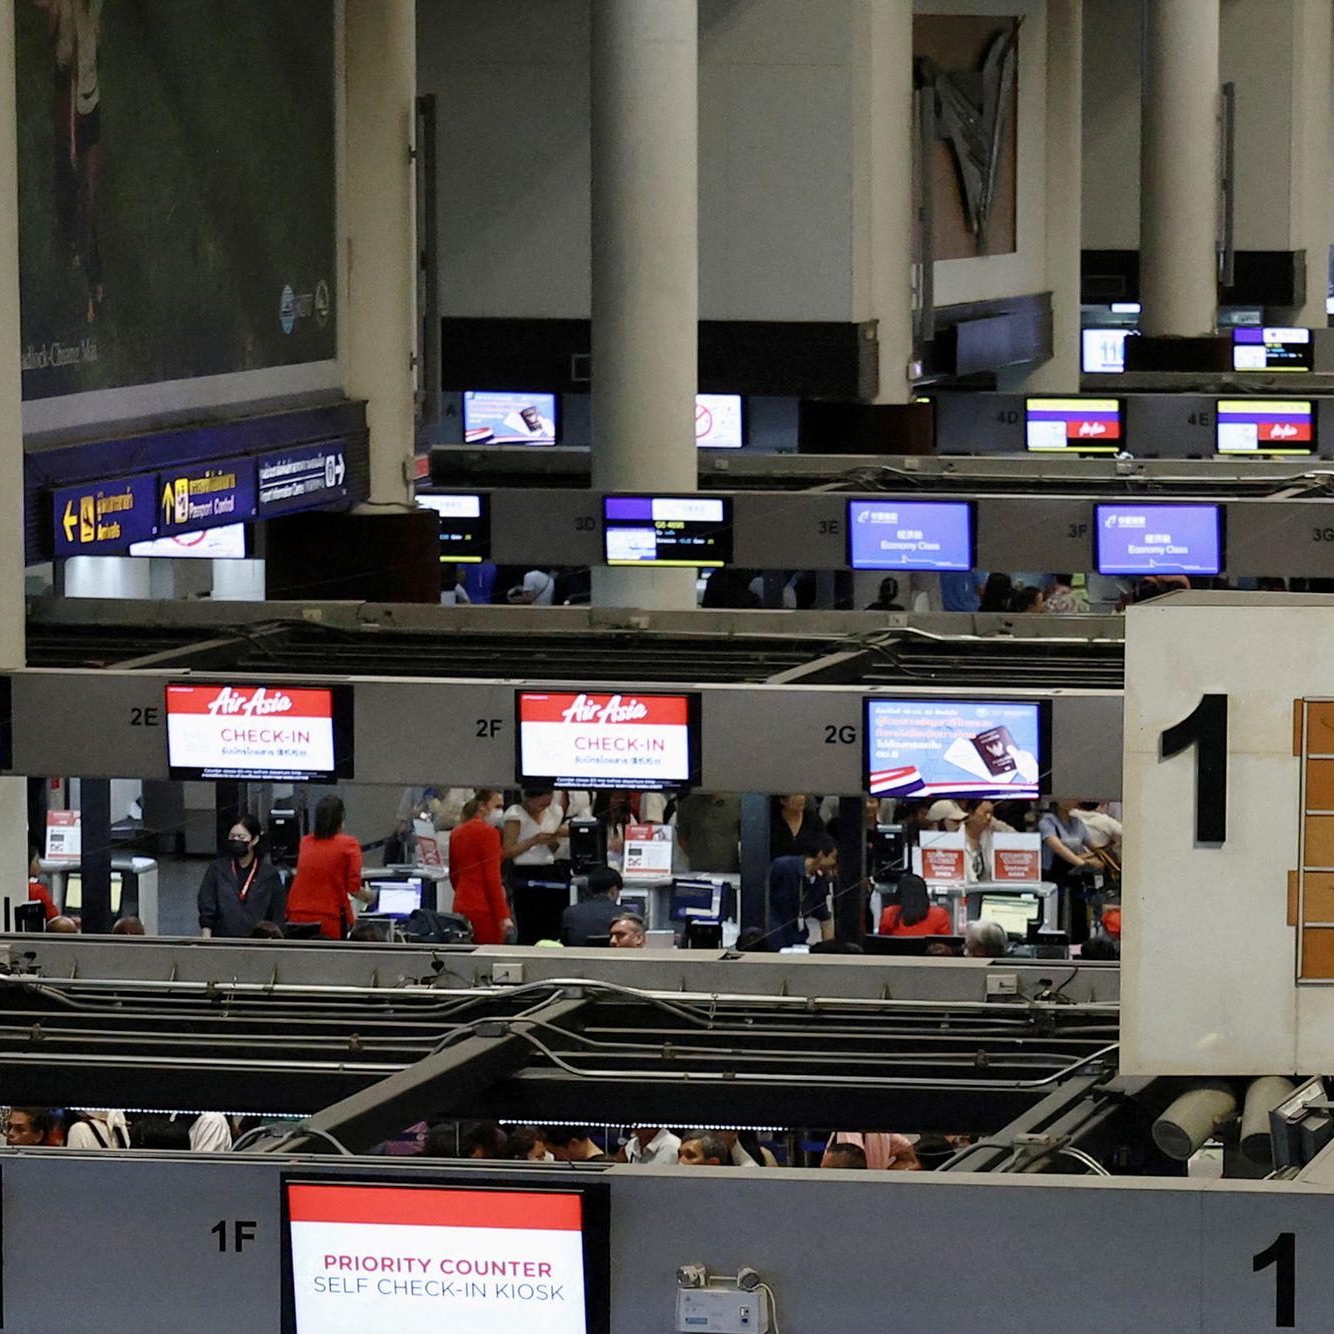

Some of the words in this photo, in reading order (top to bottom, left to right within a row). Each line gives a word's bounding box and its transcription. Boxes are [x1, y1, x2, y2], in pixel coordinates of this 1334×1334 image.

[996, 411, 1018, 425] 4D
[1188, 413, 1209, 427] 4E
[575, 517, 596, 532] 3D
[818, 520, 839, 535] 3E
[1068, 524, 1087, 539] 3F
[130, 707, 158, 726] 2E
[220, 727, 310, 744] CHECK-IN
[475, 719, 503, 738] 2F
[824, 725, 856, 745] 2G
[573, 735, 665, 752] CHECK-IN
[1160, 693, 1229, 843] 1
[211, 1220, 257, 1253] 1F
[324, 1254, 432, 1275] PRIORITY
[439, 1258, 553, 1279] COUNTER
[313, 1275, 368, 1295] SELF
[377, 1278, 488, 1299] CHECK-IN
[495, 1281, 565, 1301] KIOSK
[1252, 1232, 1297, 1328] 1
